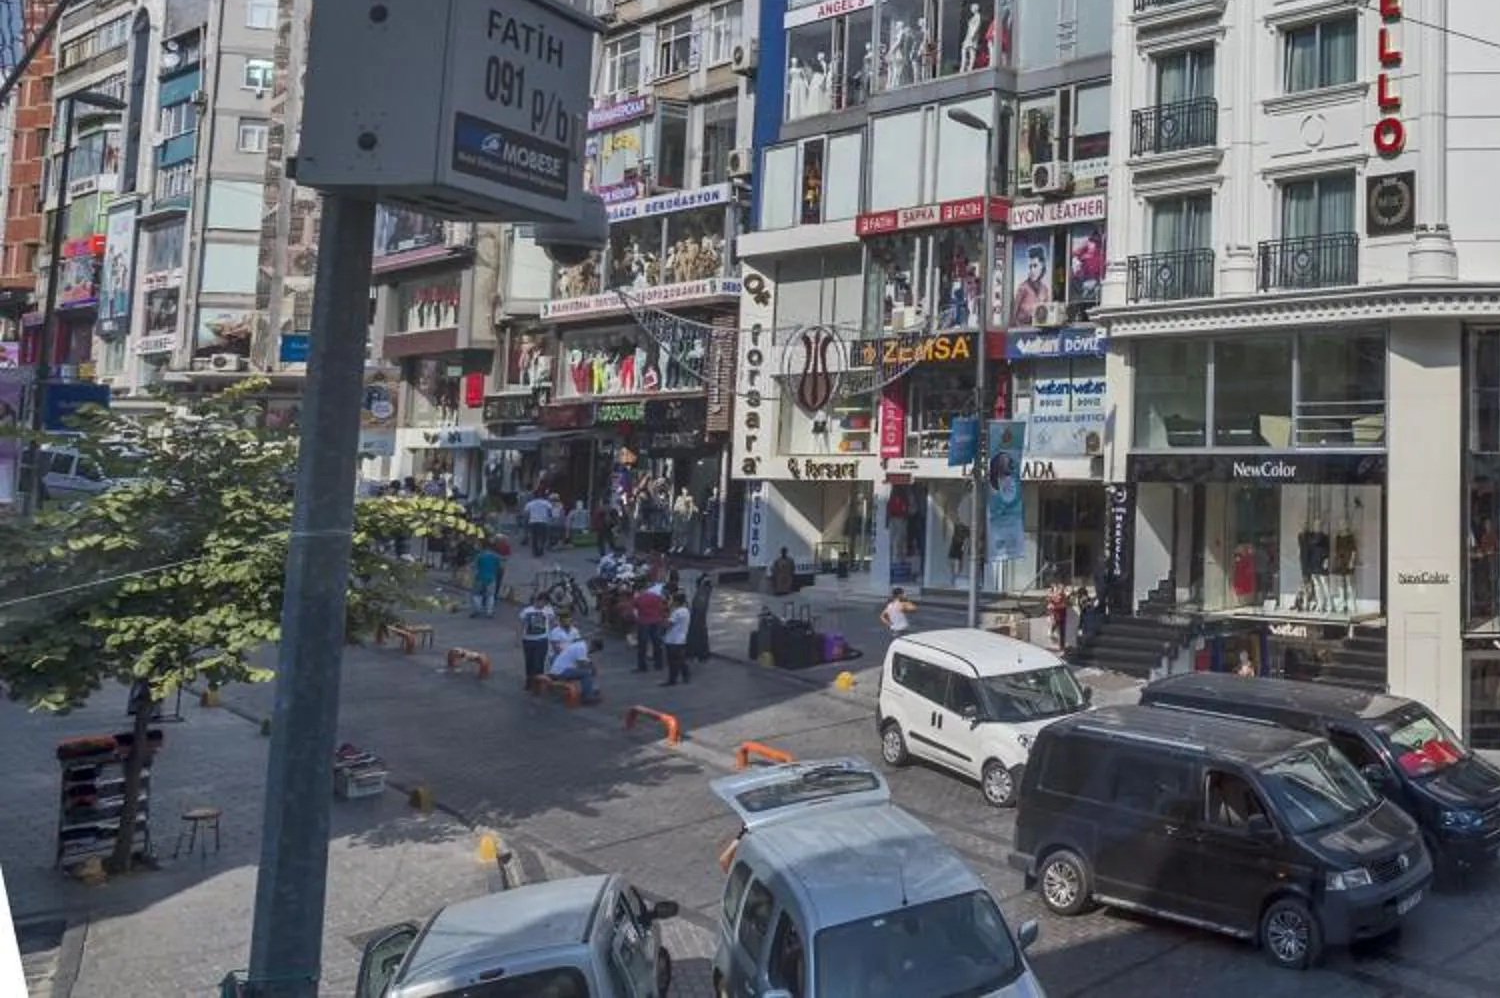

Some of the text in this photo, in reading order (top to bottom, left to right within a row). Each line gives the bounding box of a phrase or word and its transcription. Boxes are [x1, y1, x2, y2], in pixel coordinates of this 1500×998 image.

[487, 8, 564, 70] FATİH
[485, 55, 525, 110] 091
[1050, 199, 1104, 220] LEATHER
[1233, 461, 1297, 478] NewColor
